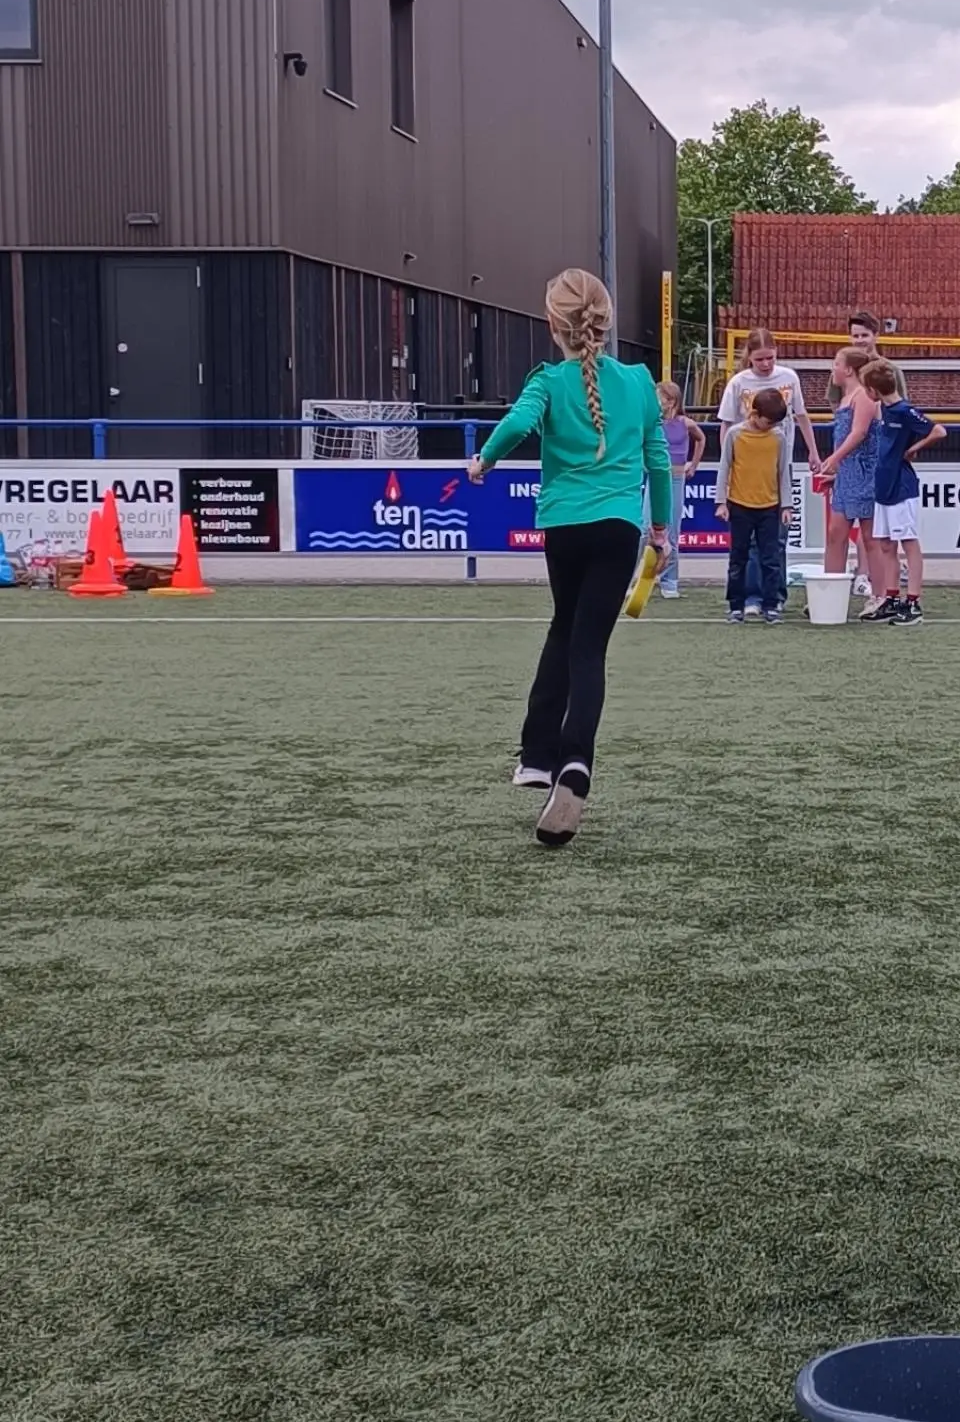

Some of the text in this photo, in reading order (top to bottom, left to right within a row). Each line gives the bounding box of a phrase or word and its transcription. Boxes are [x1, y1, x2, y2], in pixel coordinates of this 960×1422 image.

[199, 478, 252, 487] verbouw
[0, 480, 173, 503] REGELAAR
[200, 492, 265, 501] onderhoud
[47, 509, 59, 524] &
[200, 506, 258, 516] renovatie
[373, 499, 421, 525] ten
[789, 479, 802, 548] ALBERGEN
[201, 520, 252, 532] kozijnen
[201, 534, 270, 543] nieuwbouw
[402, 524, 467, 549] dam
